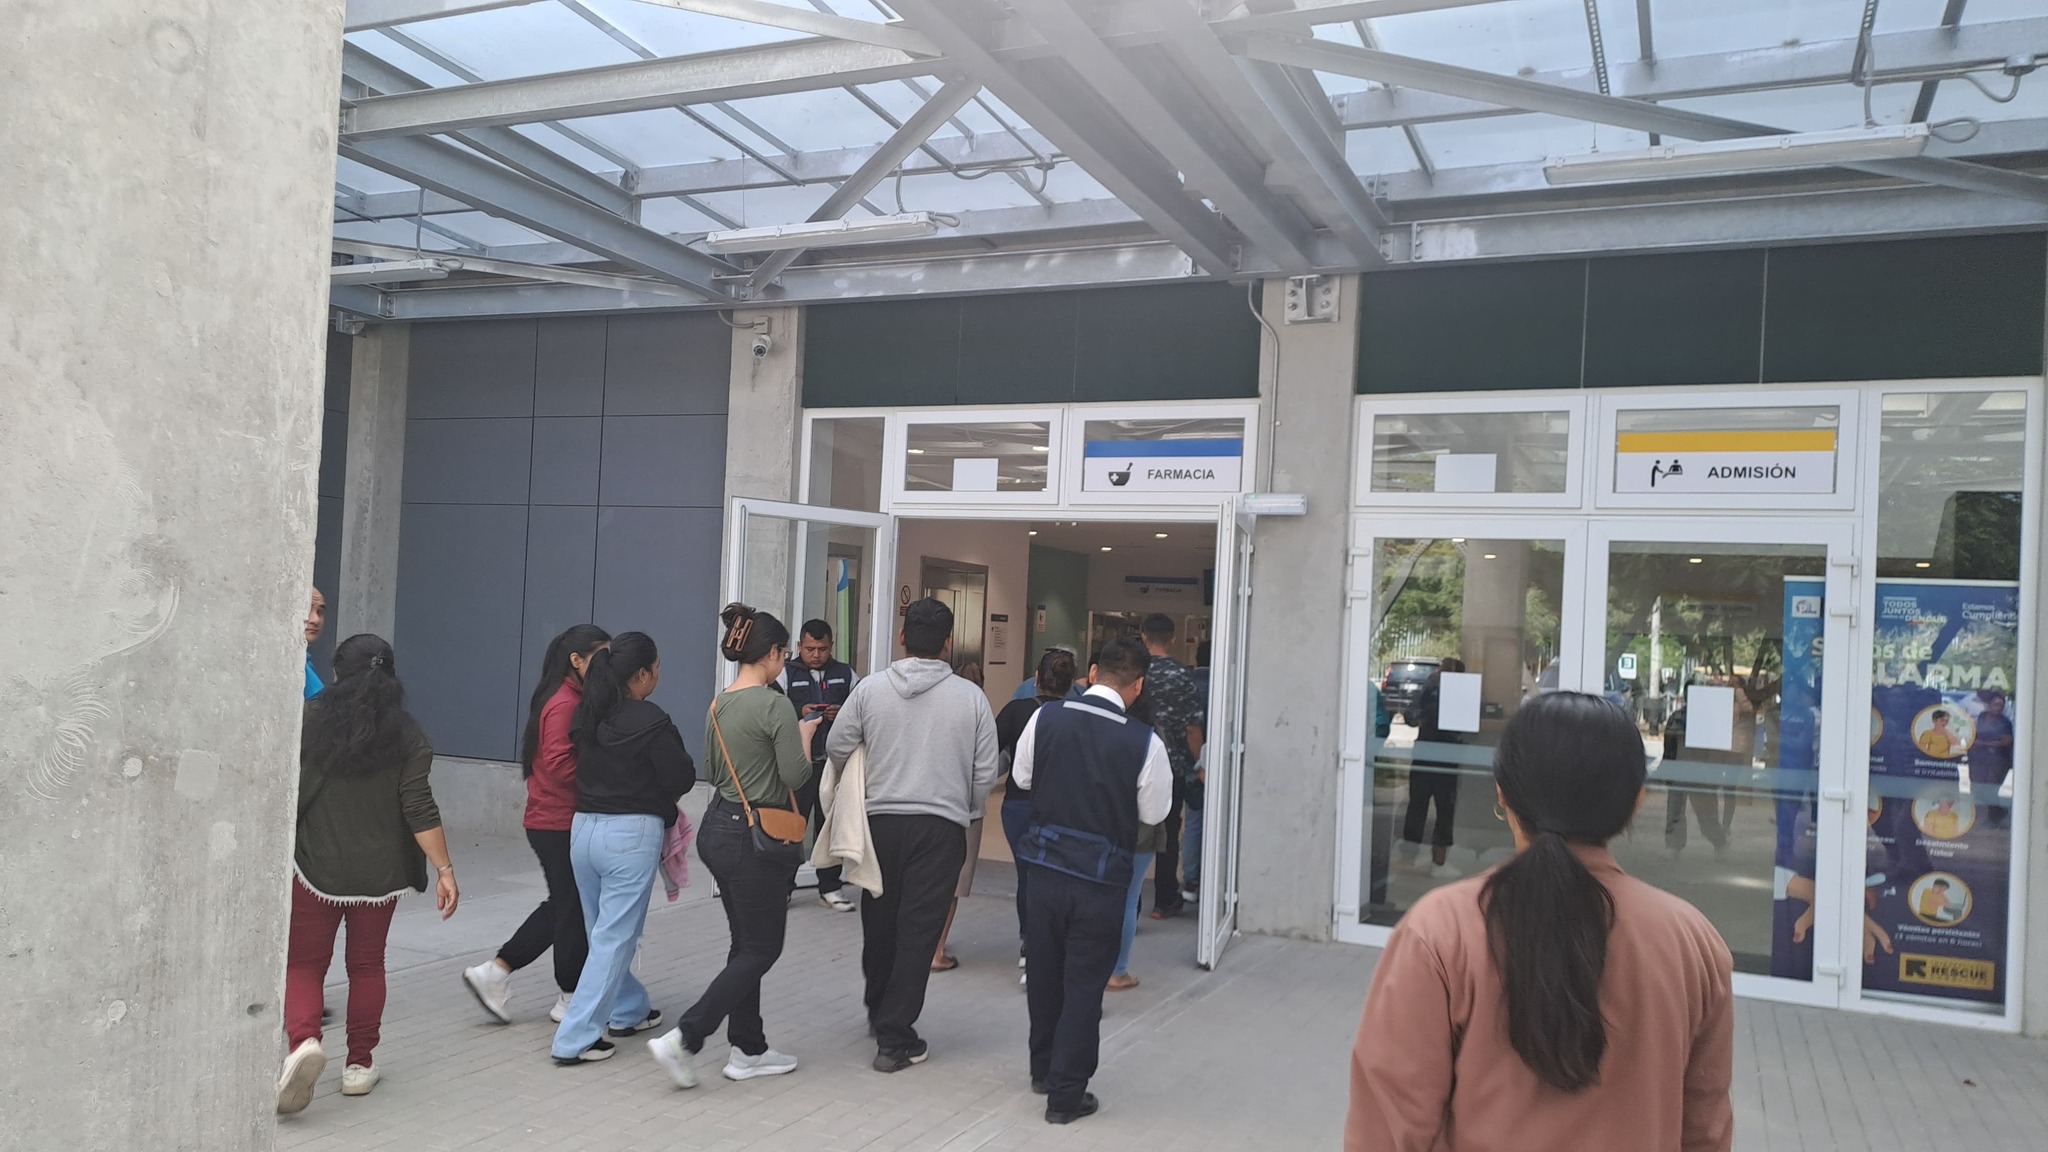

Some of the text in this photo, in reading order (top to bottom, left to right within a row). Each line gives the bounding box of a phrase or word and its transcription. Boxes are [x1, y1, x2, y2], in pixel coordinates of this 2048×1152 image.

[1147, 469, 1215, 480] FARMACIA
[1707, 463, 1796, 478] ADMISIÓN
[1902, 640, 1932, 660] de
[1876, 663, 2010, 690] LARMA
[1931, 965, 1986, 980] RESCUE
